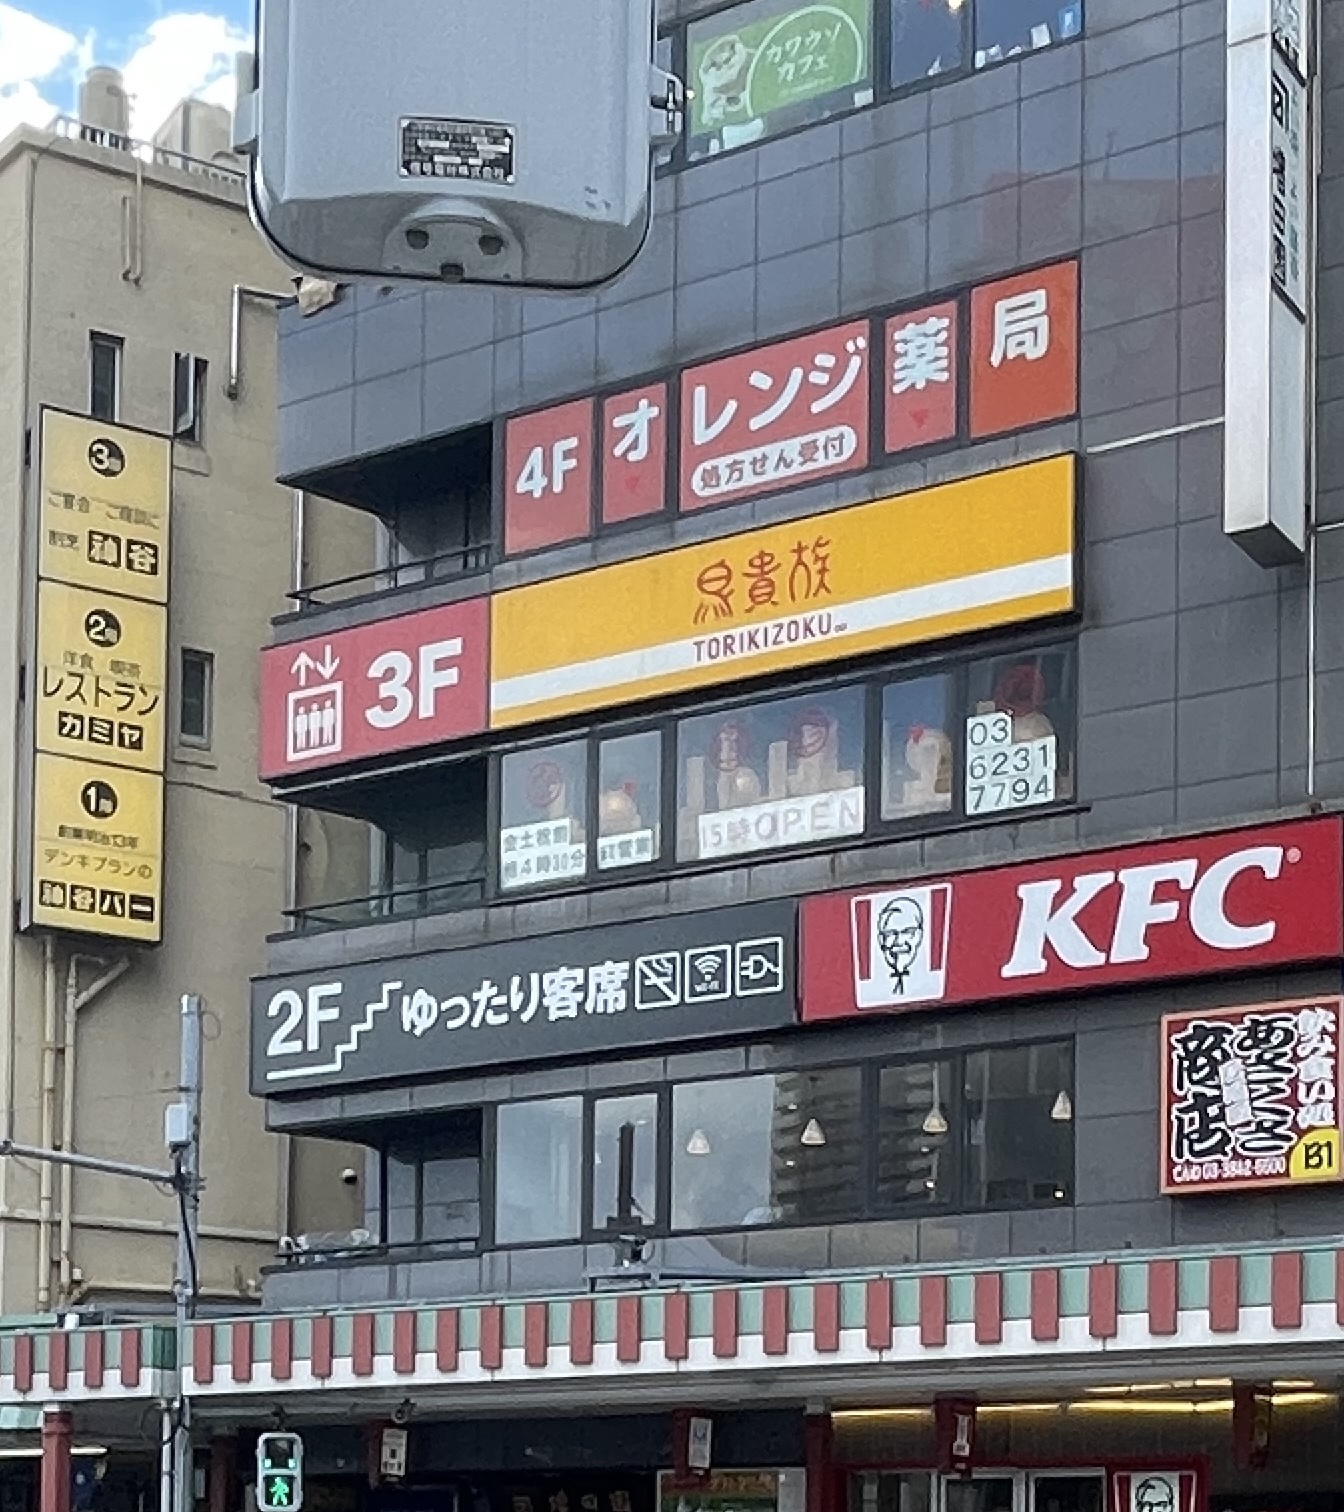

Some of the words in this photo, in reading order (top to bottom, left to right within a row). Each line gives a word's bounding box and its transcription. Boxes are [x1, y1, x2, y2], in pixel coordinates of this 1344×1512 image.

[767, 22, 842, 63] カワウソ
[777, 54, 830, 82] カフェ
[517, 437, 578, 498] 4F
[612, 288, 1049, 462] オレンジ薬局
[698, 430, 846, 492] 処方せん受付
[692, 535, 834, 624] 鳥貴族
[692, 612, 834, 663] TORIKIZOKU
[42, 664, 160, 717] レストラン
[365, 636, 463, 730] 3F
[57, 710, 144, 751] カミヤ
[969, 718, 1009, 747] 03
[969, 743, 1051, 781] 6231
[969, 774, 1052, 812] 7794
[1001, 846, 1284, 979] KFC
[266, 982, 343, 1058] 2F
[400, 960, 631, 1037] ゆったり客席
[1303, 1140, 1333, 1170] B1
